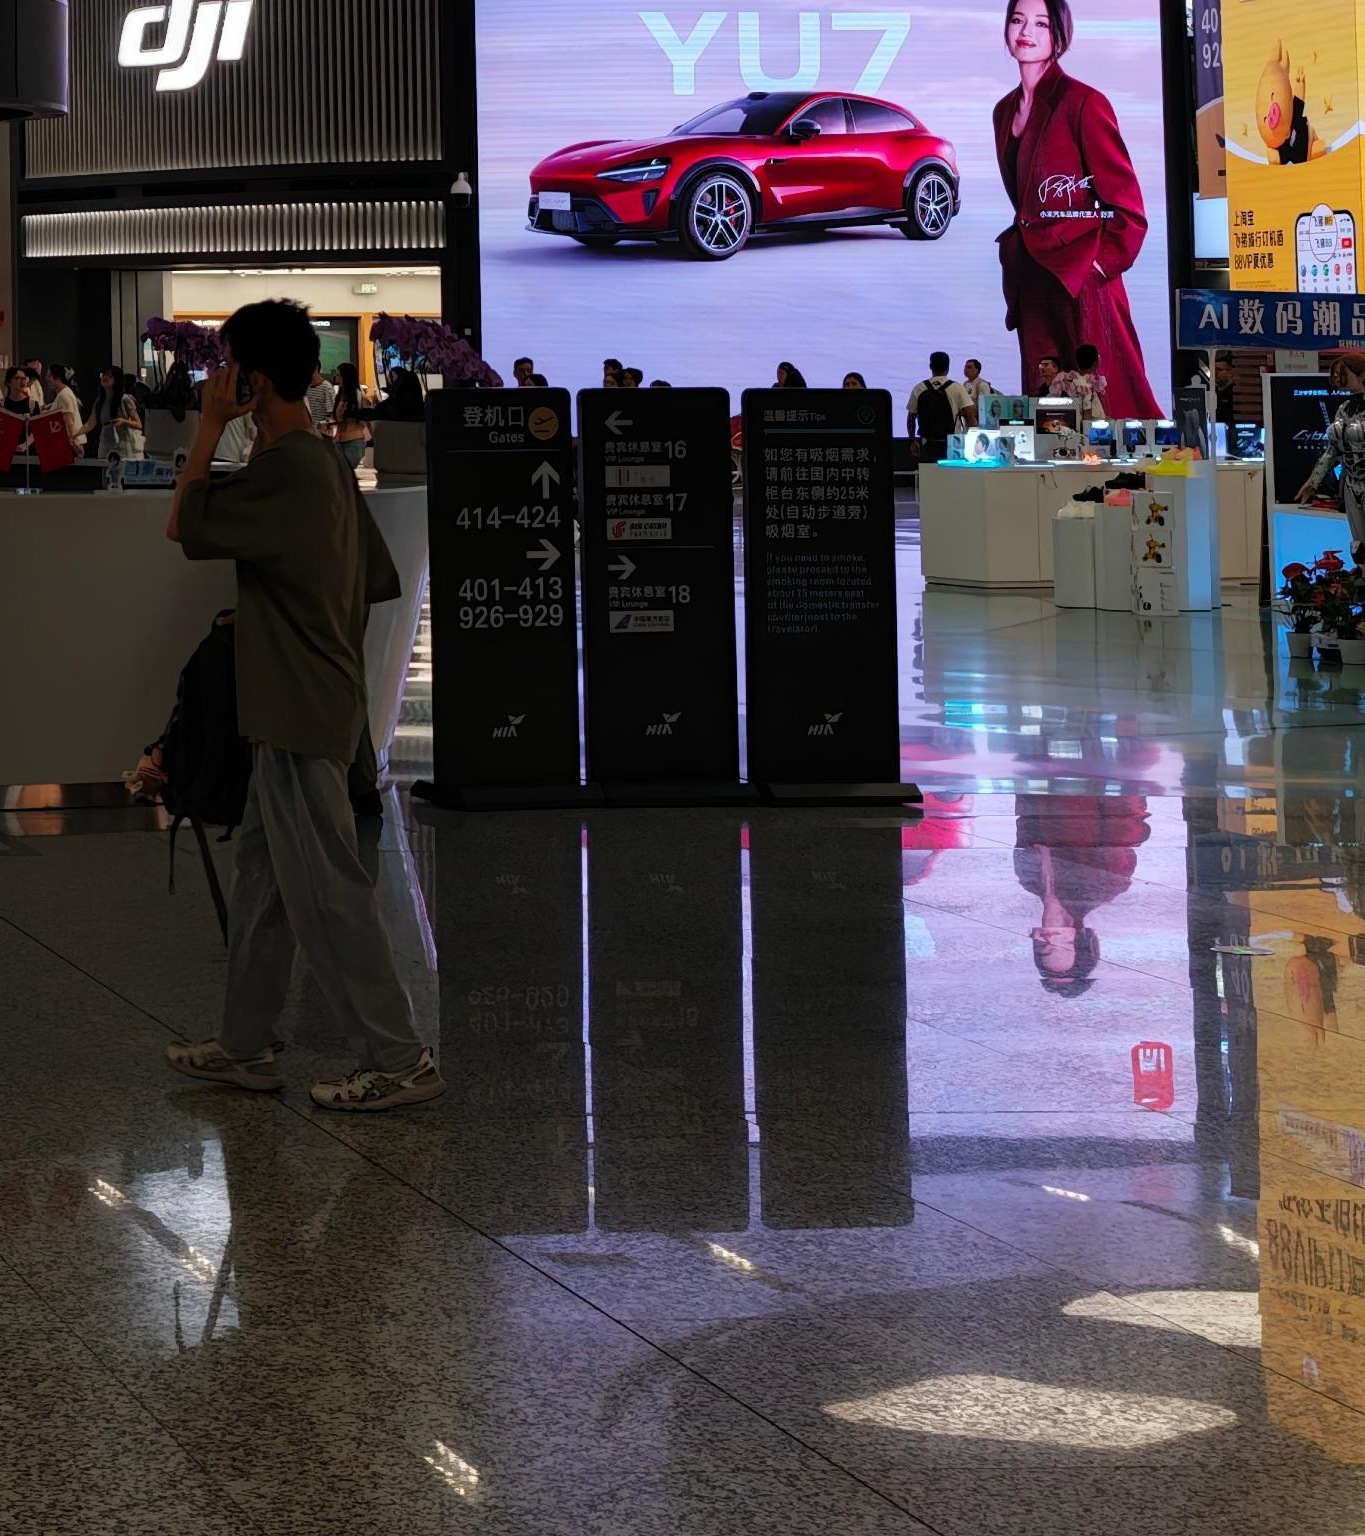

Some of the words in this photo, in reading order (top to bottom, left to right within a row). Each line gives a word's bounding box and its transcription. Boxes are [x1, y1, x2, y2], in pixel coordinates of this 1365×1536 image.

[638, 10, 910, 95] YU7
[1199, 303, 1229, 330] AI
[462, 405, 525, 428] 登机口
[489, 430, 525, 445] Gates
[664, 440, 687, 459] 16
[765, 467, 869, 482] 请前往国内中转
[666, 493, 688, 512] 17
[765, 486, 869, 501] 柜台东侧约25米
[456, 505, 561, 530] 414-424
[459, 576, 563, 602] 401-413
[669, 585, 691, 604] 18
[459, 604, 564, 630] 926-929
